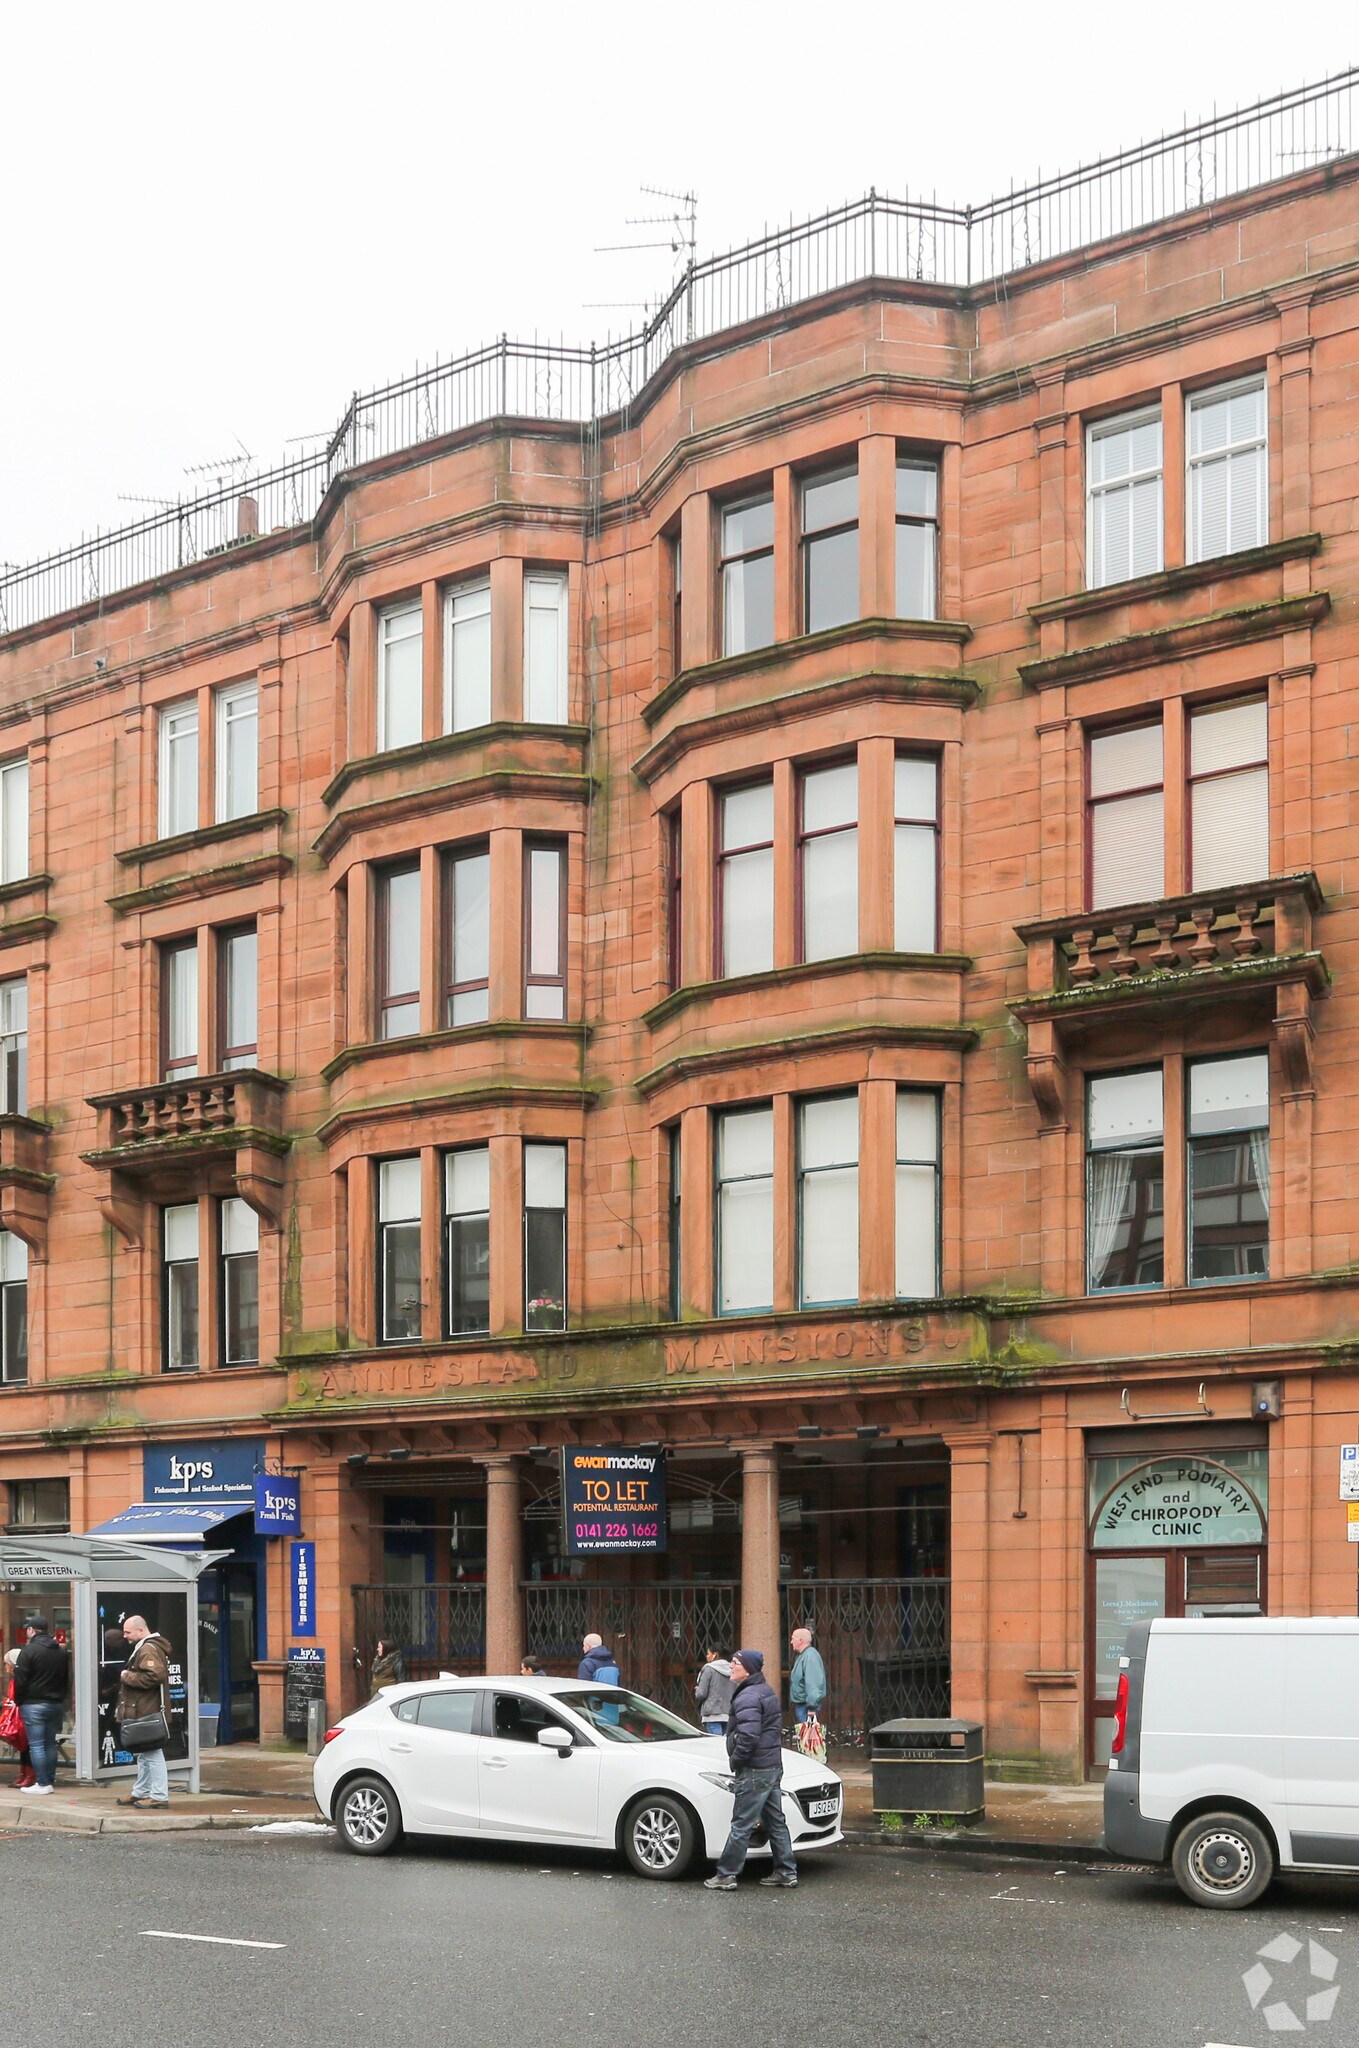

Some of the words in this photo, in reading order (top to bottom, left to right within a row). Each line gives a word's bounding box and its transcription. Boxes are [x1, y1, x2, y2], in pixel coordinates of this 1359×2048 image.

[319, 1354, 578, 1399] ANNIESLAND
[664, 1325, 926, 1375] MANSIONS
[573, 1454, 656, 1473] ewanmackay
[169, 1455, 213, 1492] kp's
[191, 1485, 201, 1493] and
[202, 1484, 223, 1493] Seafood
[224, 1484, 253, 1492] Specialists
[582, 1480, 611, 1501] TO
[616, 1480, 649, 1501] LET
[1104, 1492, 1133, 1530] WEST
[1131, 1473, 1163, 1496] END
[1177, 1468, 1250, 1514] PODIATRY
[1162, 1491, 1190, 1503] and
[264, 1490, 296, 1519] kp's
[573, 1503, 612, 1512] POTENTIAL
[613, 1503, 658, 1512] RESTAURANT
[260, 1510, 276, 1519] Fresh
[281, 1512, 295, 1521] Fish
[1131, 1506, 1222, 1521] CHIROPODY
[575, 1523, 602, 1537] 0141
[605, 1523, 628, 1537] 226
[632, 1523, 658, 1537] 1662
[1152, 1522, 1202, 1536] CLINIC
[576, 1539, 657, 1549] www.ewanmackay.com
[7, 1567, 33, 1576] GREAT
[34, 1566, 73, 1575] WESTERN
[297, 1548, 308, 1623] FISHMONGER
[203, 1621, 219, 1635] DAILY
